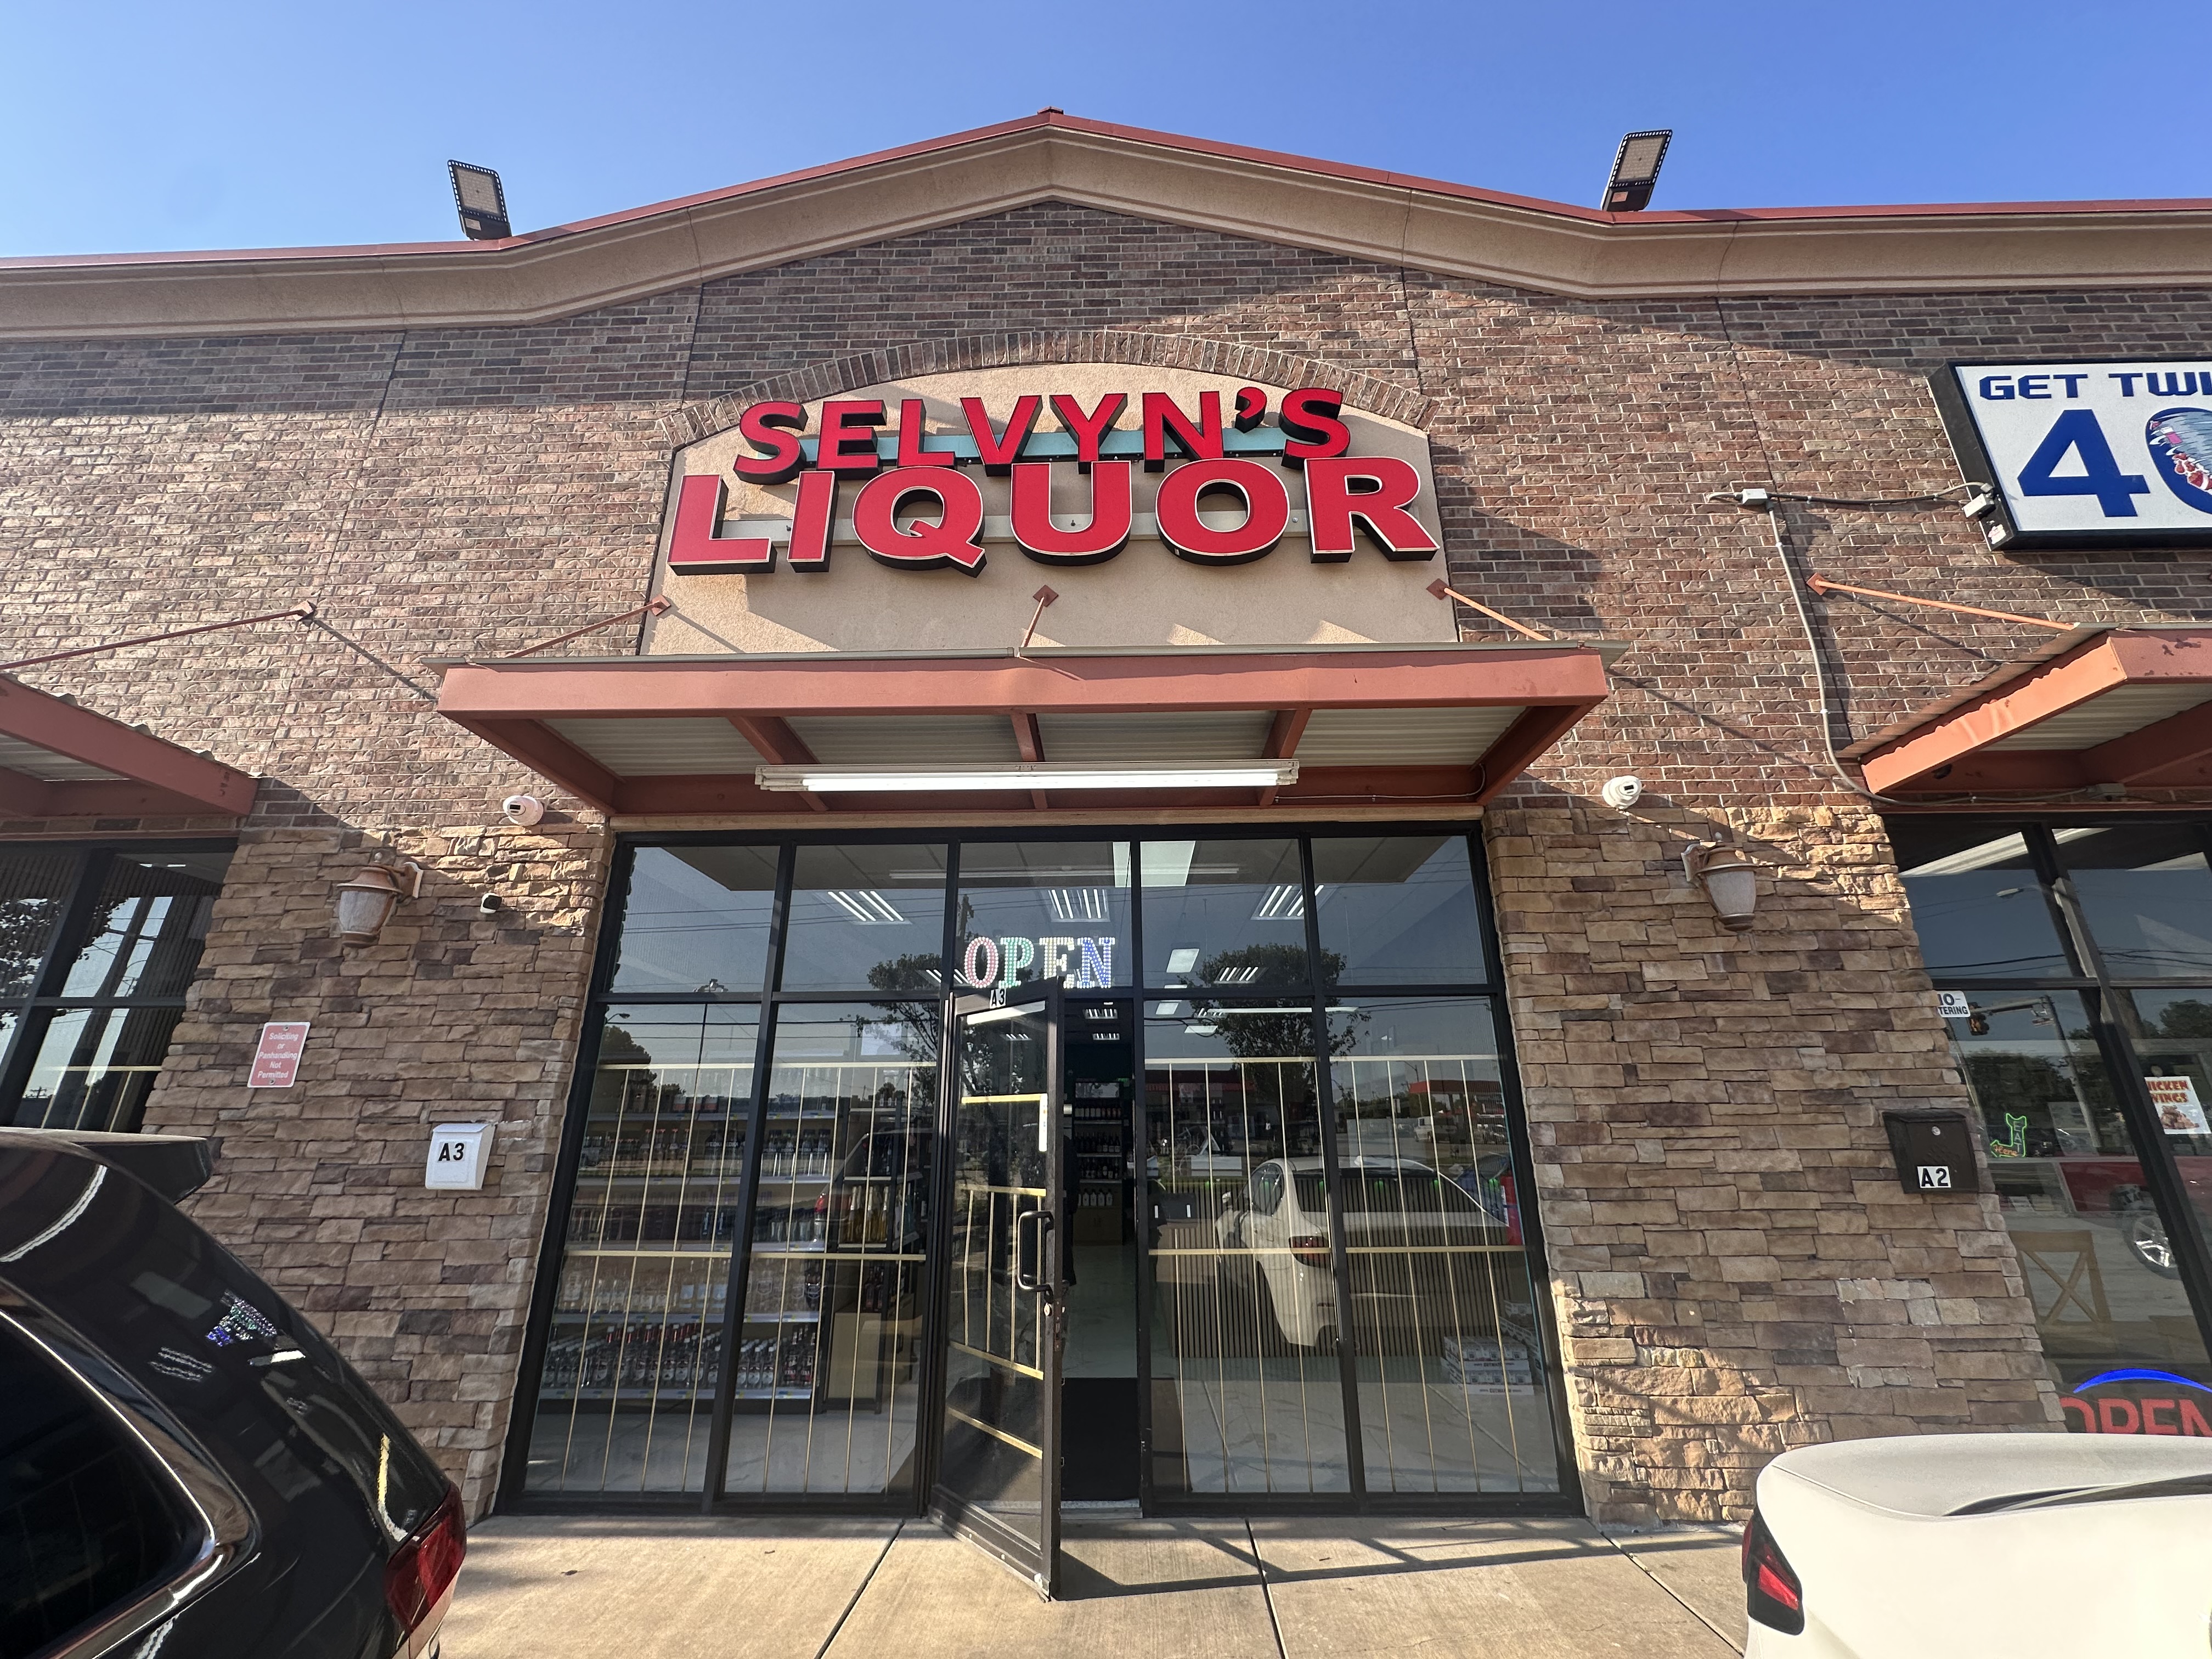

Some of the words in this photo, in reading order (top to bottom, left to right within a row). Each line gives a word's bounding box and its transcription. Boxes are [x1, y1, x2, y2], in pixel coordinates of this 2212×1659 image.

[1979, 374, 2088, 399] GET
[733, 386, 1350, 484] SELVYN'S
[668, 456, 1440, 578] LIQUOR
[964, 936, 1116, 988] OPEN
[991, 989, 1006, 1007] A3
[269, 1032, 299, 1041] Soliciting
[258, 1052, 297, 1060] Panhandling
[2013, 1121, 2023, 1153] EAT
[438, 1142, 465, 1161] A3
[1921, 1167, 1949, 1187] A2
